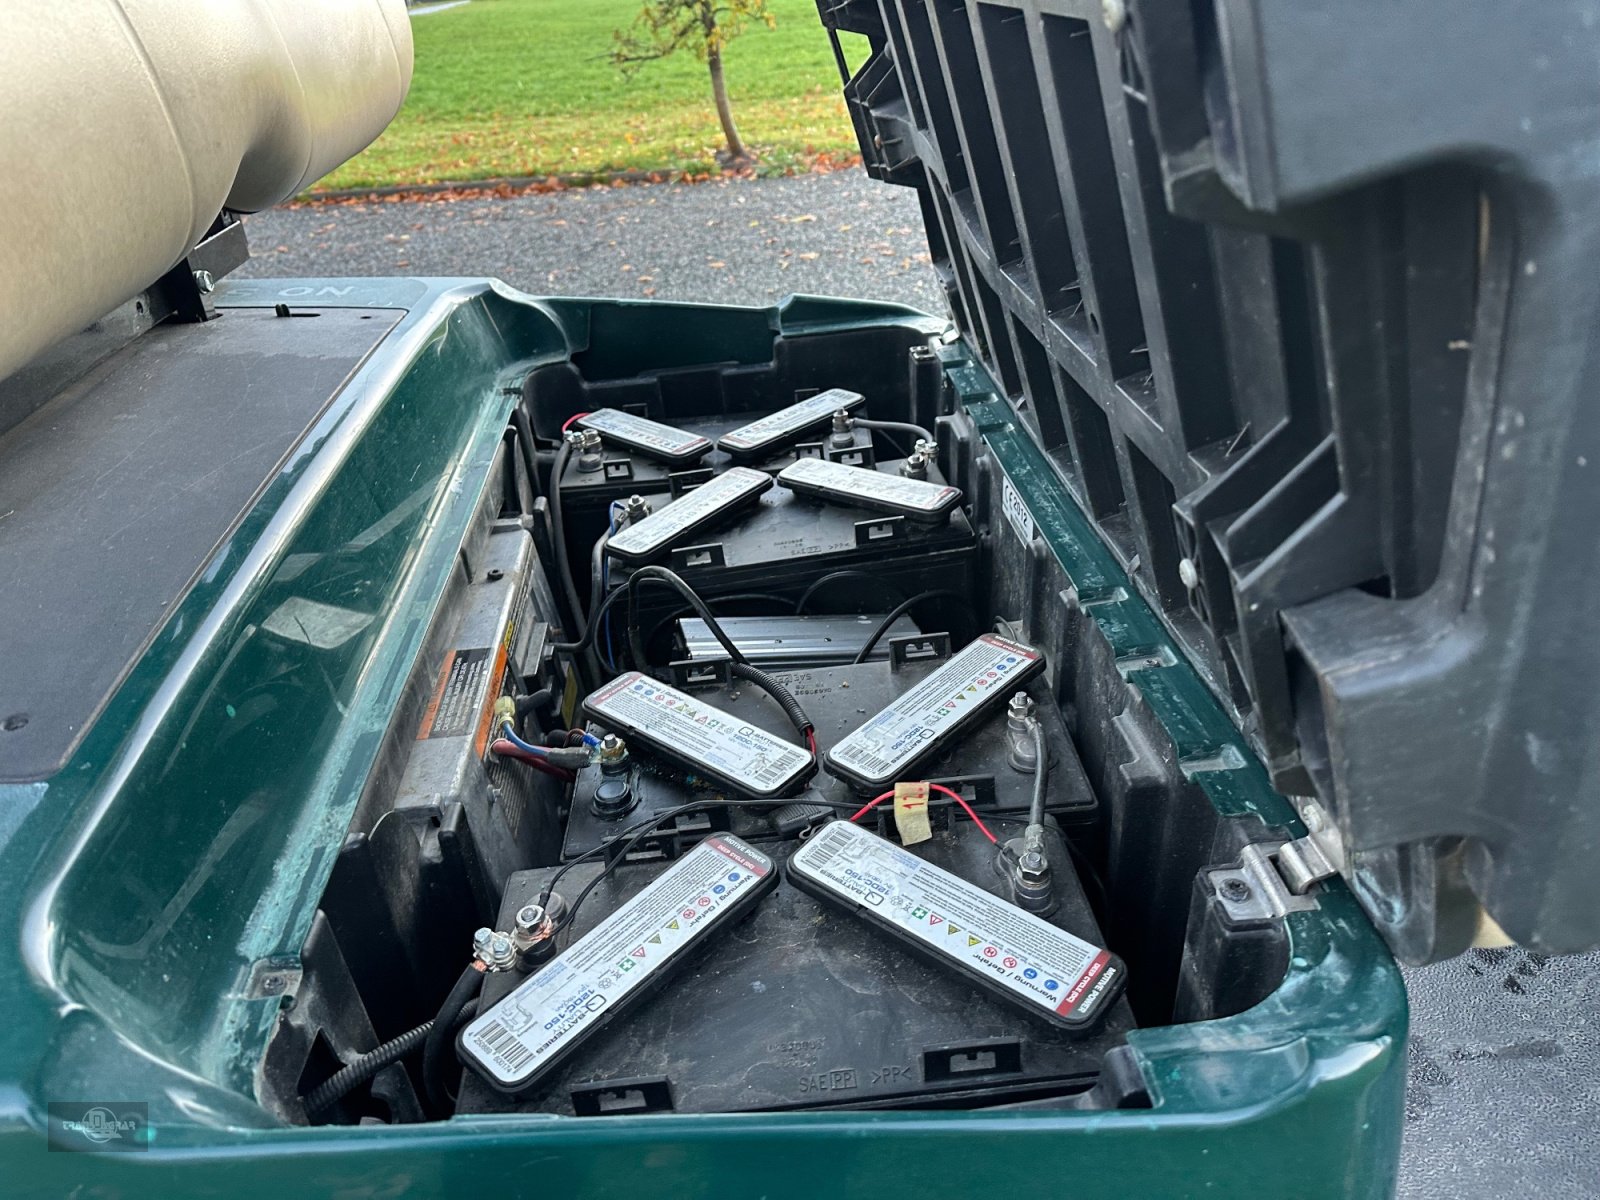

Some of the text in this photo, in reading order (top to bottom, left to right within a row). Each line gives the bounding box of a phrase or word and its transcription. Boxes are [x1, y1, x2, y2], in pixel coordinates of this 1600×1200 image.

[723, 835, 766, 864] MOTIVE POWER
[728, 851, 746, 863] CYCLE
[717, 873, 753, 901] Warnung
[843, 867, 892, 896] 12DC-150
[687, 904, 716, 928] Gefahr
[970, 952, 1006, 975] Gefahr
[1086, 961, 1101, 977] DEEP
[1012, 973, 1059, 1003] Warnung
[1074, 974, 1091, 992] CYCLE
[1076, 965, 1117, 1014] MOTIVE POWER
[542, 986, 596, 1031] 12DC-150
[799, 1073, 828, 1093] SAE
[871, 1066, 912, 1085] >PP<
